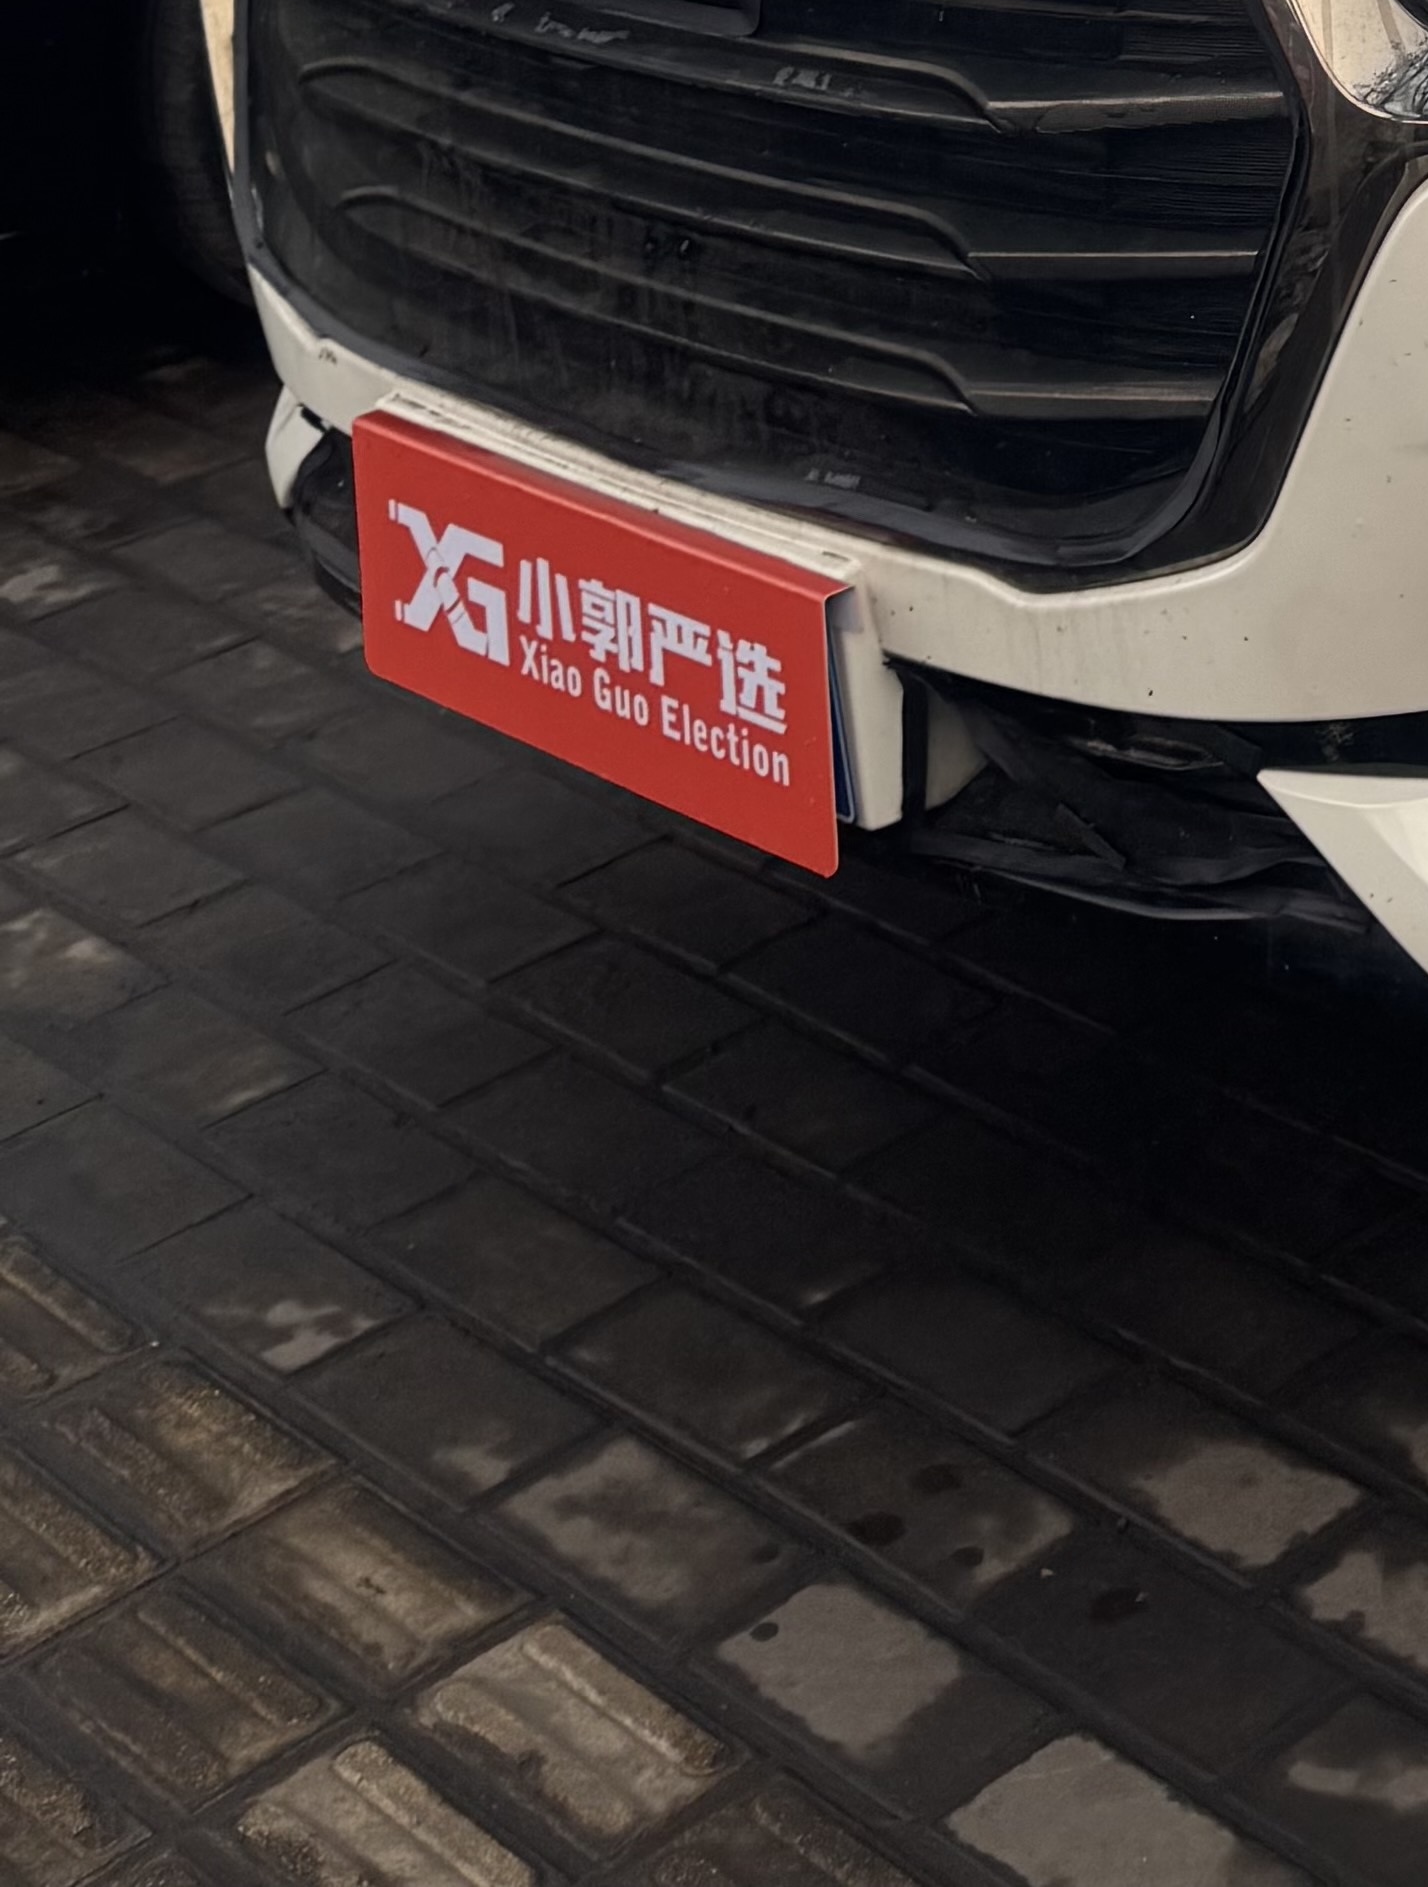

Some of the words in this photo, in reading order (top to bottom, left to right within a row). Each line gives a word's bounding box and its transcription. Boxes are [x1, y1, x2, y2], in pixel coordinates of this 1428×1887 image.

[517, 557, 788, 735] 小郭严选
[520, 635, 582, 699] Xiao
[593, 667, 650, 728] Guo
[661, 695, 790, 786] Election
